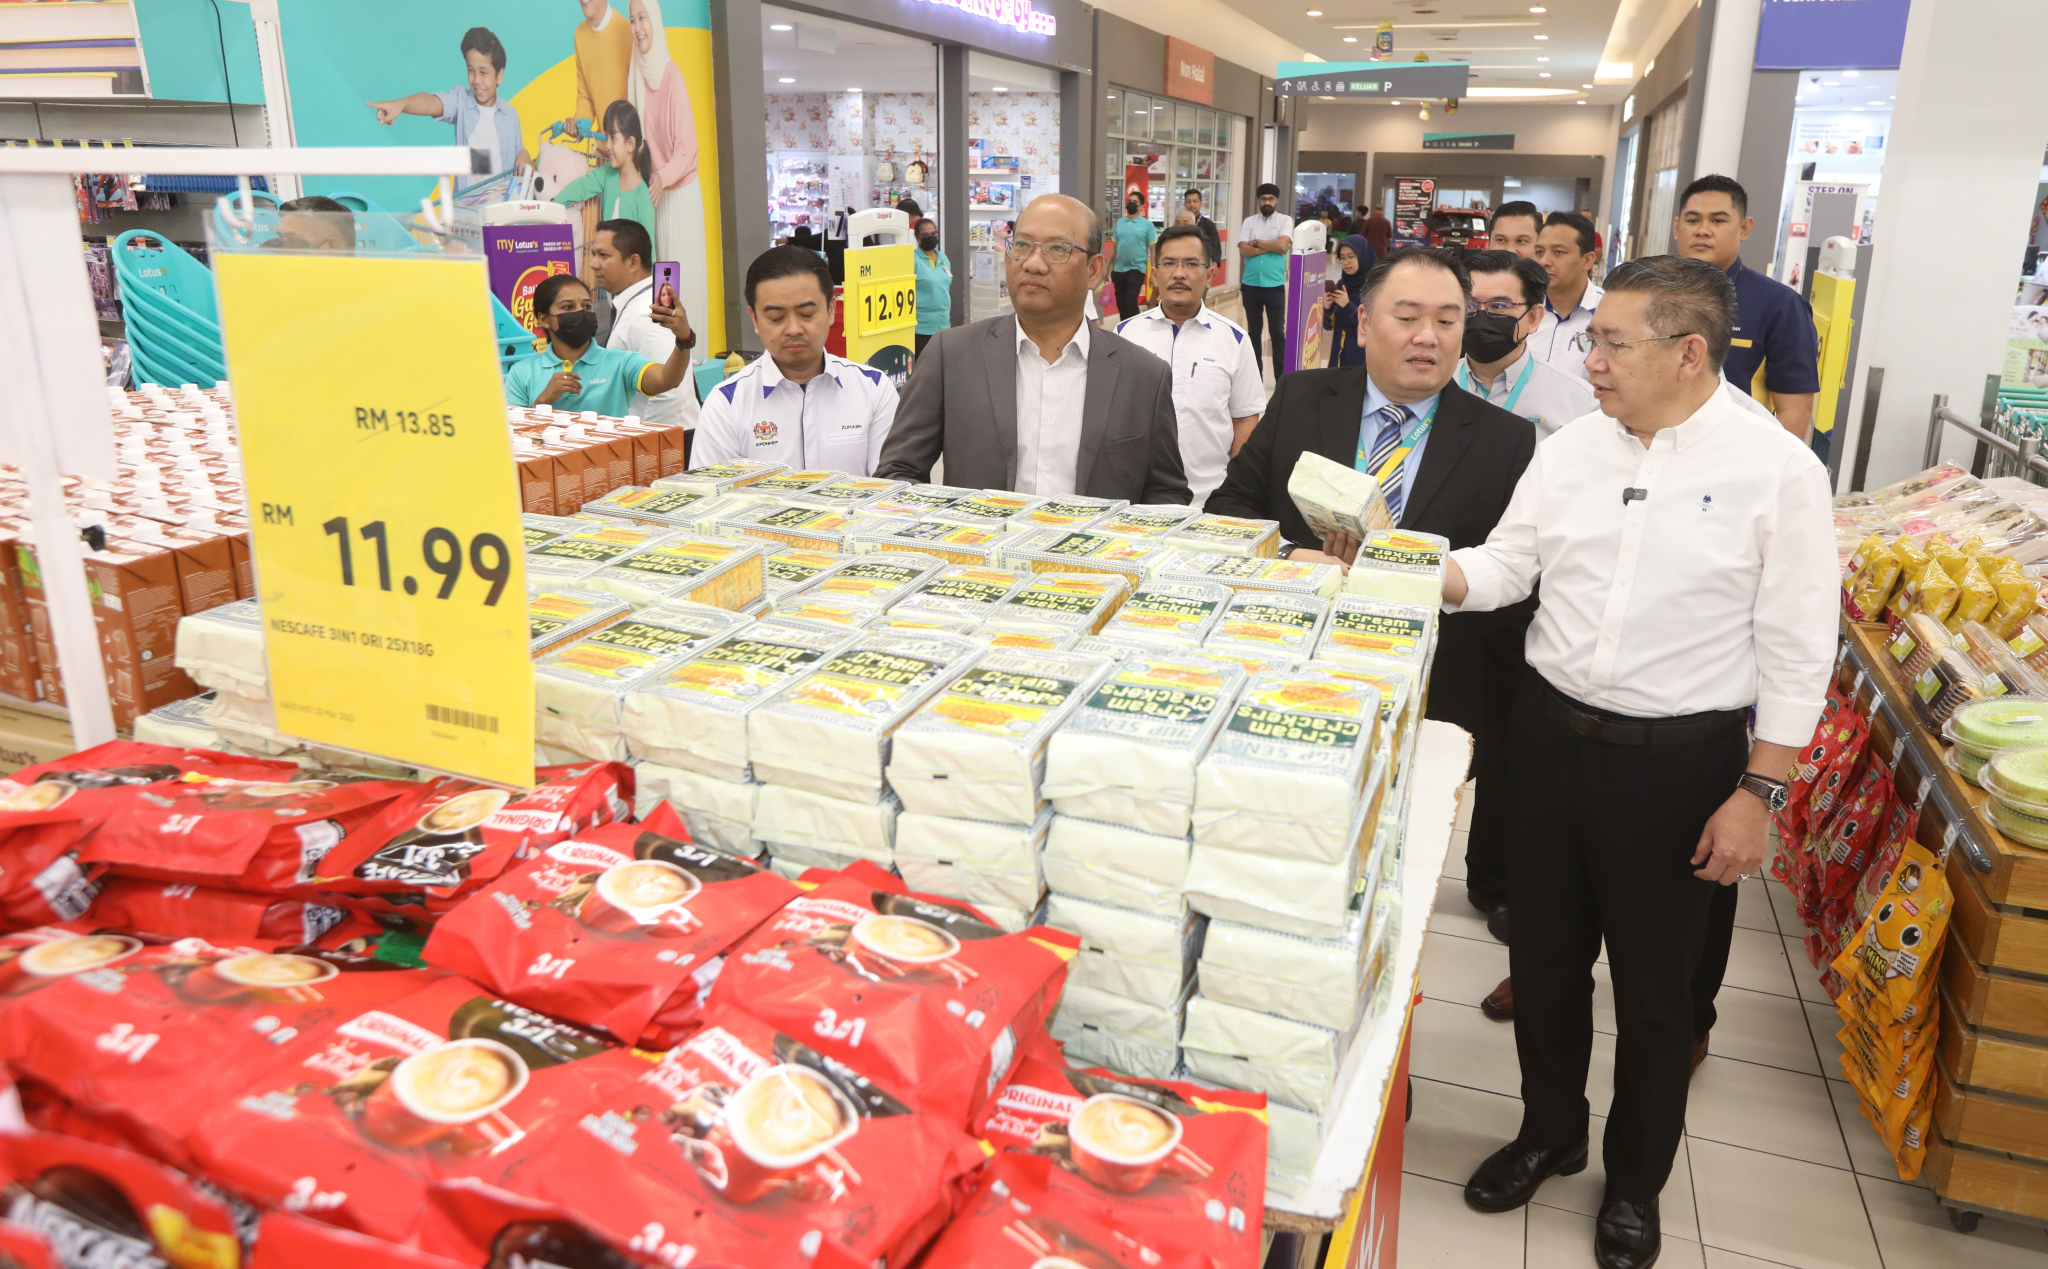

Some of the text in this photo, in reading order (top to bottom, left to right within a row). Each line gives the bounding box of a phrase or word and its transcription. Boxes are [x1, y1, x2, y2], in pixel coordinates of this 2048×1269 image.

[1180, 60, 1205, 83] Non Halal
[1351, 82, 1393, 92] KELUAR P
[497, 239, 539, 253] my Lotus's
[138, 266, 168, 278] Lotus's
[860, 264, 872, 277] RM
[865, 289, 915, 322] 12.99
[355, 406, 456, 437] RM 13.85
[1410, 417, 1433, 441] Lotus's
[262, 502, 294, 526] RM
[322, 516, 512, 607] 11.99
[1365, 547, 1441, 560] Crackers
[1375, 553, 1428, 566] Cream
[857, 563, 910, 575] Cream
[928, 580, 1008, 596] Crackers
[1018, 590, 1100, 607] Crackers
[1023, 599, 1080, 612] Cream
[1126, 599, 1212, 616] Crackers
[1243, 604, 1304, 619] Cream
[1348, 613, 1410, 628] Cream
[623, 623, 692, 643] Cream
[1332, 617, 1421, 637] Crackers
[270, 618, 435, 657] NESCAFE 3IN1 ORI 25X18G
[733, 639, 805, 659] Cream
[851, 650, 927, 673] Cream
[981, 670, 1060, 691] Cream
[1099, 683, 1217, 712] Crackers
[1106, 697, 1191, 721] Cream
[1236, 705, 1362, 737] Crackers
[1248, 721, 1337, 746] Cream
[493, 811, 554, 828] ORIGINAL
[1000, 1089, 1075, 1112] ORIGINAL
